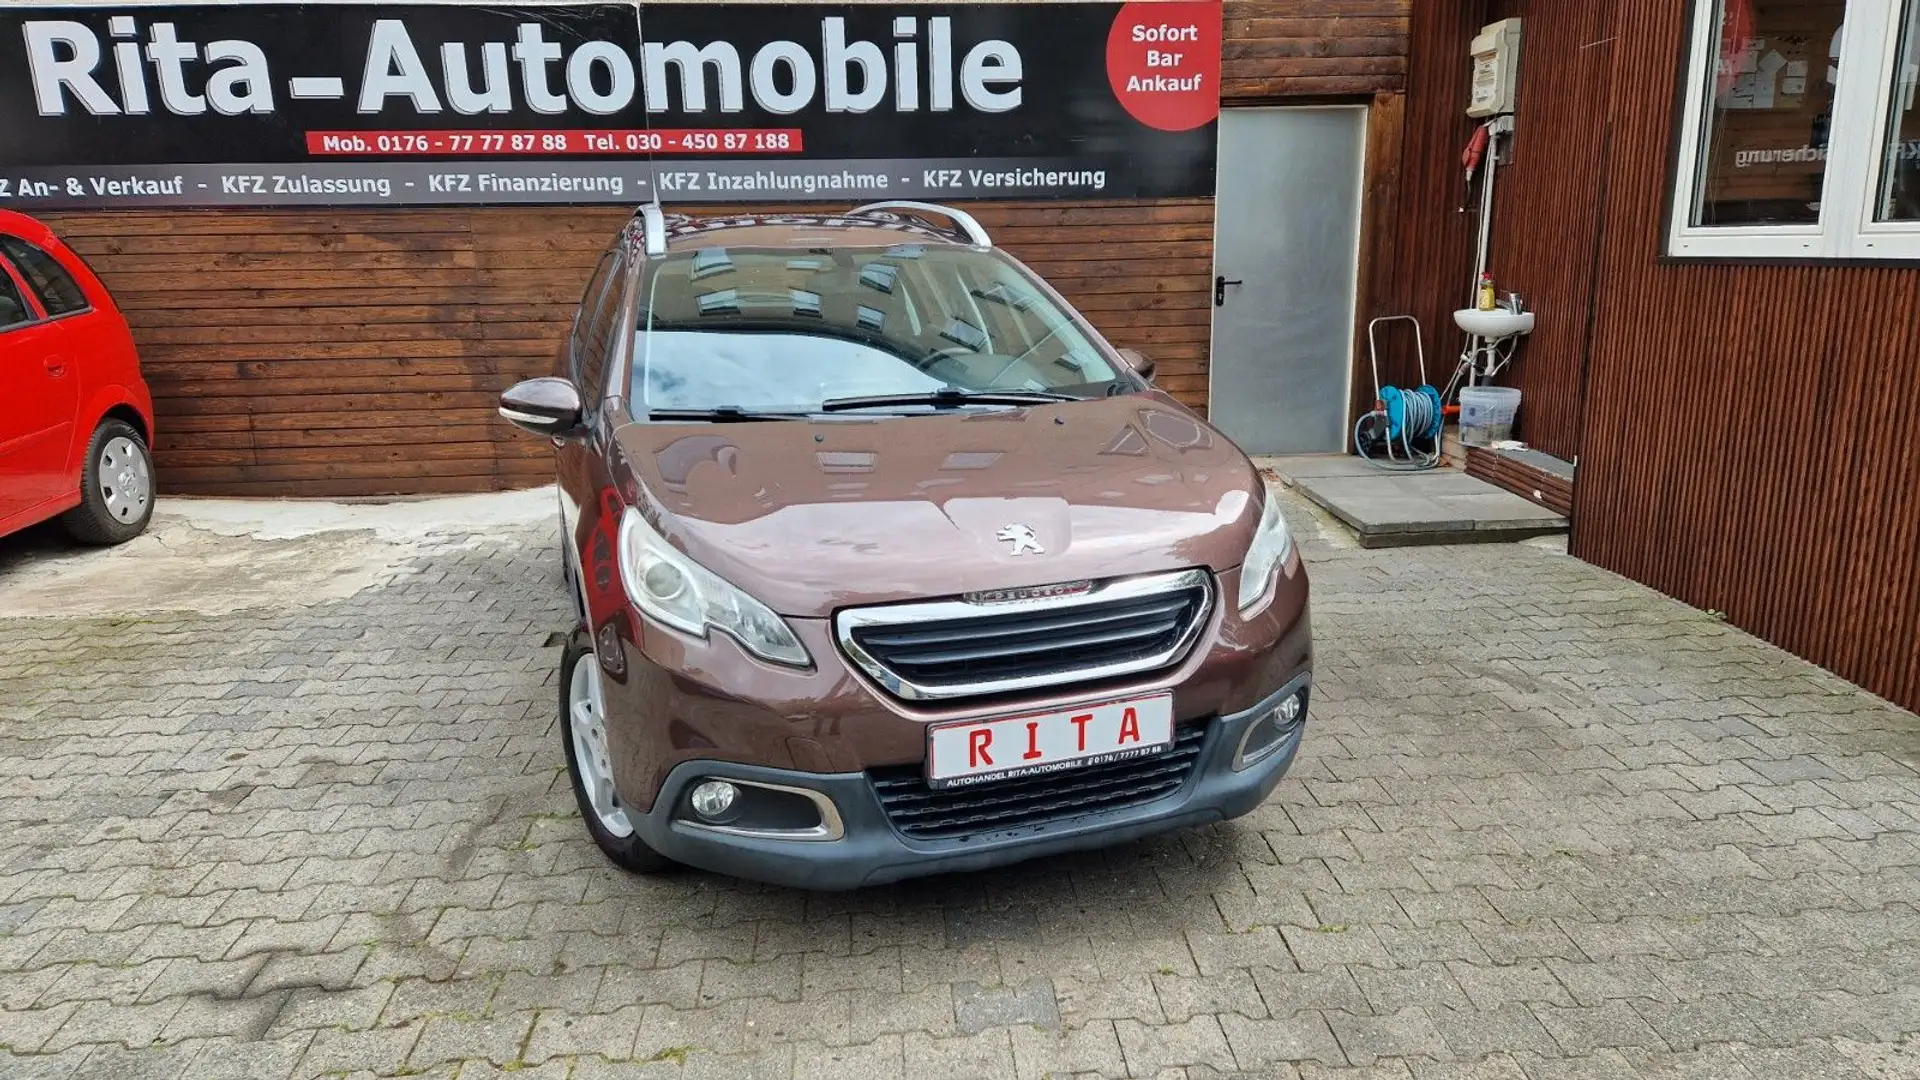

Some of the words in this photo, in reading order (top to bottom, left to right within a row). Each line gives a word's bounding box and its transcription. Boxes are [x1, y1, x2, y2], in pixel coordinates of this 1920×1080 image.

[1131, 24, 1198, 42] Sofort
[1147, 50, 1183, 67] Bar
[1126, 73, 1202, 92] Ankauf
[323, 135, 372, 151] Mob.
[378, 135, 429, 151] 0176
[449, 135, 473, 151] 77
[480, 135, 504, 150] 77
[511, 134, 535, 150] 87
[542, 134, 567, 150] 88
[584, 134, 620, 150] Tel.
[626, 133, 661, 150] 030
[682, 133, 718, 149] 450
[724, 133, 747, 149] 87
[755, 133, 790, 149] 188
[18, 178, 59, 196] An-
[66, 177, 86, 196] &
[90, 175, 183, 196] Verkauf
[221, 175, 267, 194] KFZ
[272, 174, 392, 198] Zulassung
[428, 173, 472, 193] KFZ
[478, 172, 624, 196] Finanzierung
[659, 173, 701, 192] KFZ
[707, 170, 888, 193] Inzahlungnahme
[923, 169, 962, 188] KFZ
[968, 168, 1106, 190] Versicherung
[946, 771, 1007, 787] AUTOHANDEL
